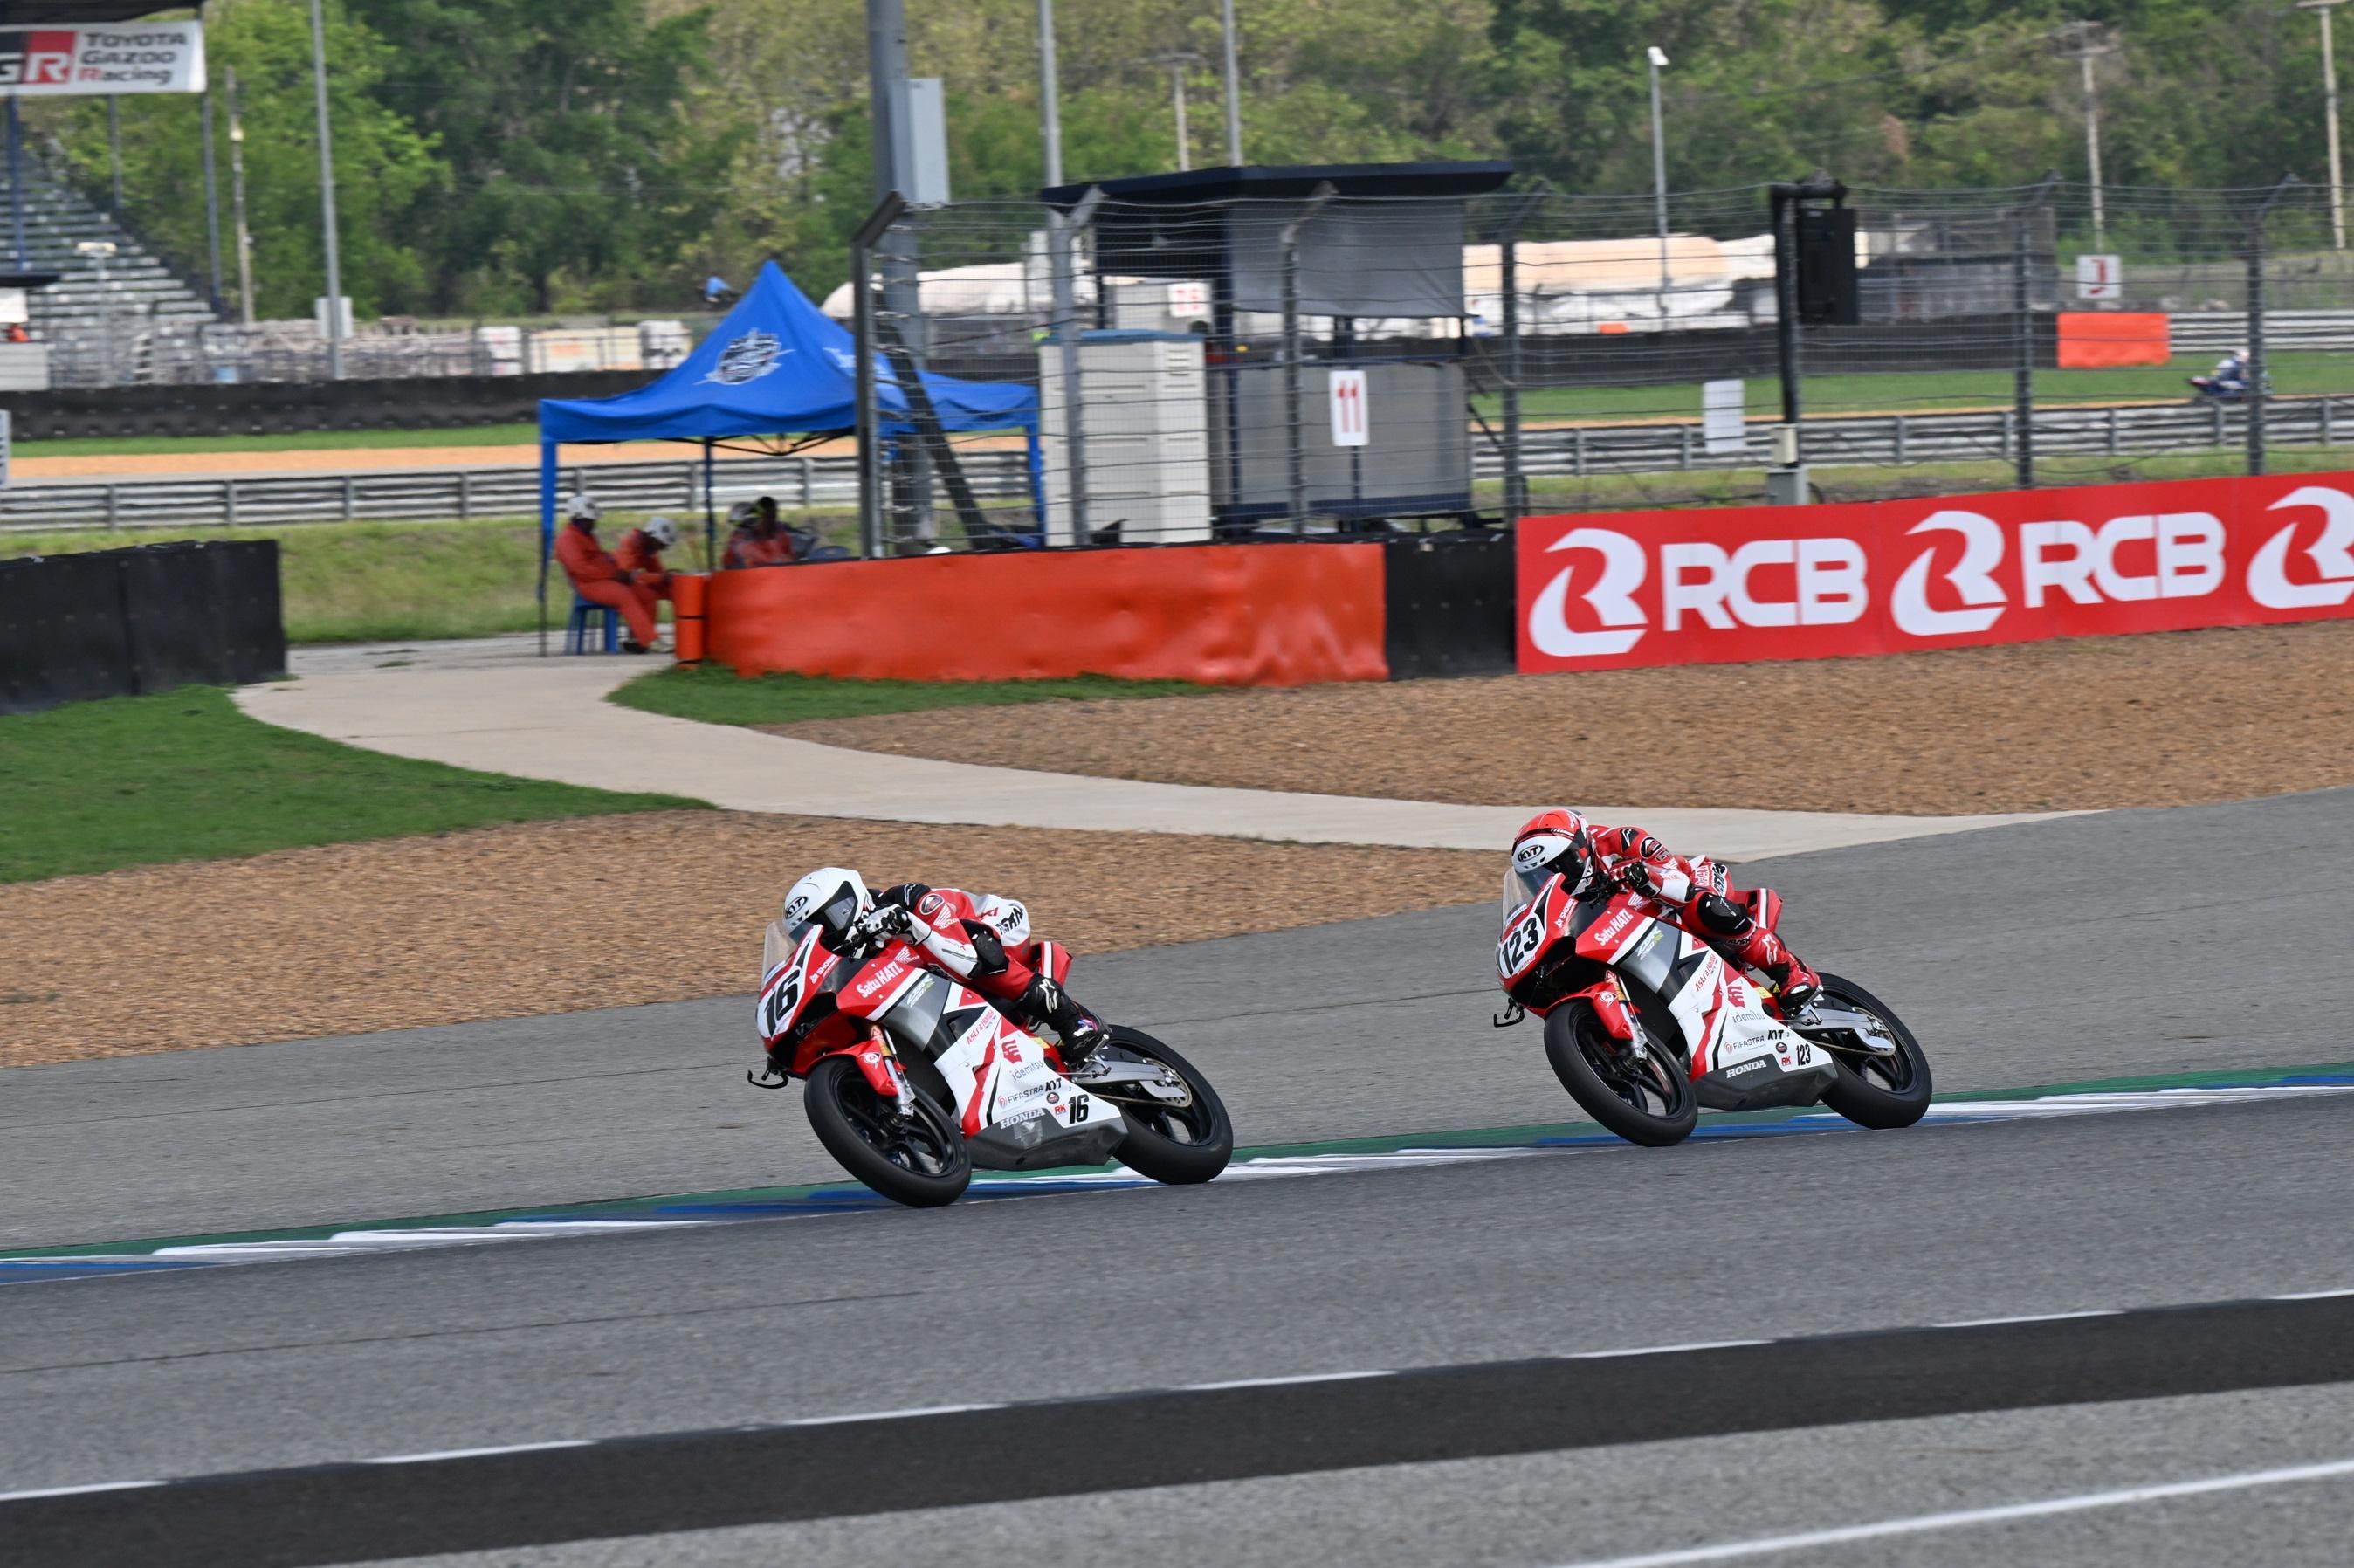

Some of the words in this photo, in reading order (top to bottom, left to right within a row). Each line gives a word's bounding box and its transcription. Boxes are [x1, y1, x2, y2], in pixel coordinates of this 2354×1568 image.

[79, 65, 172, 85] Racing
[2020, 512, 2225, 608] RCB
[1660, 538, 1869, 632] RCB
[1519, 845, 1538, 861] KYT
[1593, 925, 1617, 946] Satu
[1501, 917, 1539, 977] 123
[856, 978, 882, 999] Satu
[1695, 968, 1710, 993] Astra
[764, 968, 801, 1038] 16
[1731, 1009, 1766, 1024] idemitsu
[967, 1022, 984, 1045] Astra
[1767, 1029, 1785, 1040] KYT
[1781, 1056, 1792, 1065] RK
[1796, 1043, 1811, 1067] 123
[1009, 1060, 1043, 1081] idemitsu
[1726, 1059, 1767, 1079] HONDA
[1045, 1077, 1063, 1092] KYT
[1000, 1108, 1046, 1130] HONDA
[1055, 1104, 1066, 1115] RK
[1068, 1094, 1090, 1124] 16
